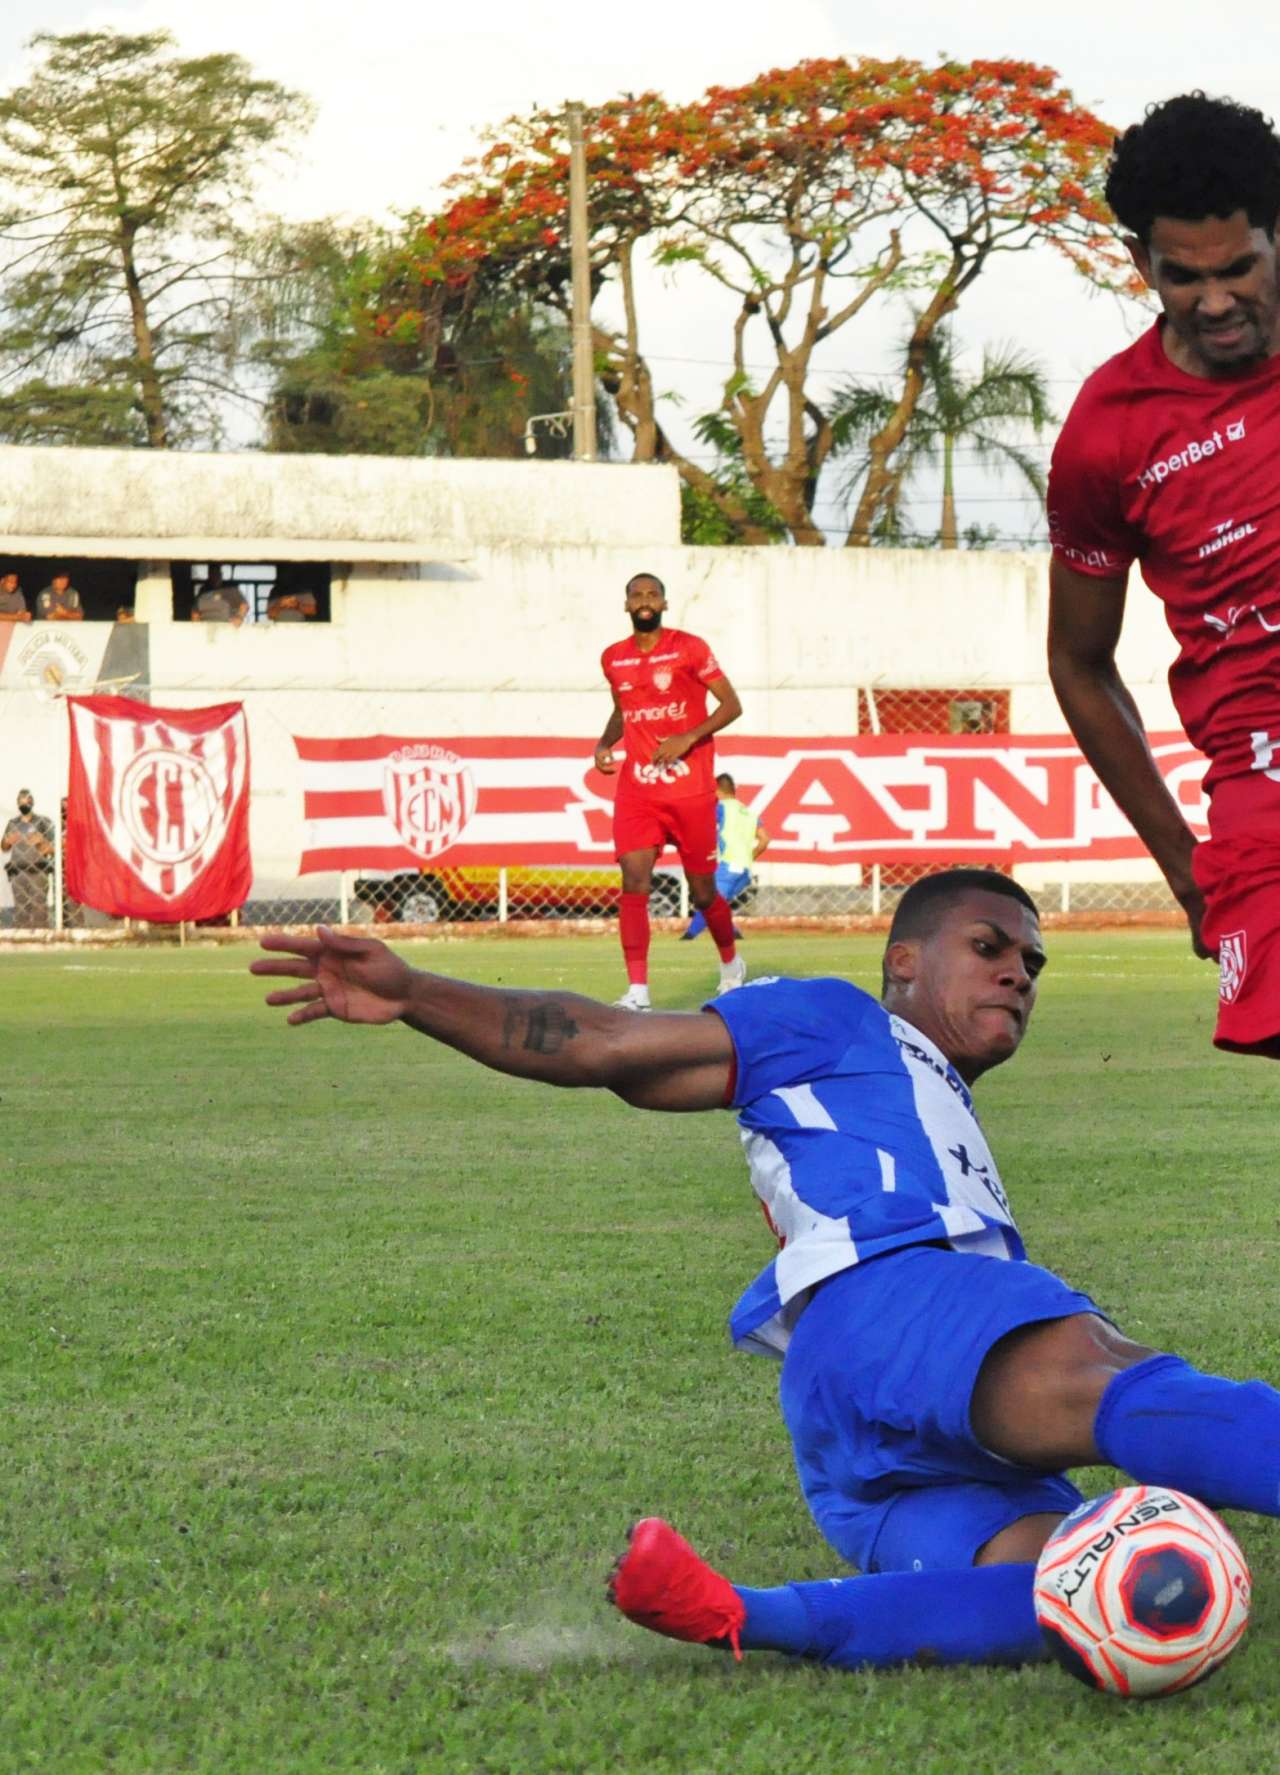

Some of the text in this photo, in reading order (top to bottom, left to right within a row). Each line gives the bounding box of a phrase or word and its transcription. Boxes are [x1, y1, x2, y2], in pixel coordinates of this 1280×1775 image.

[134, 761, 213, 851] ECN
[406, 787, 454, 833] ECN
[1063, 1497, 1182, 1608] PENALTY
